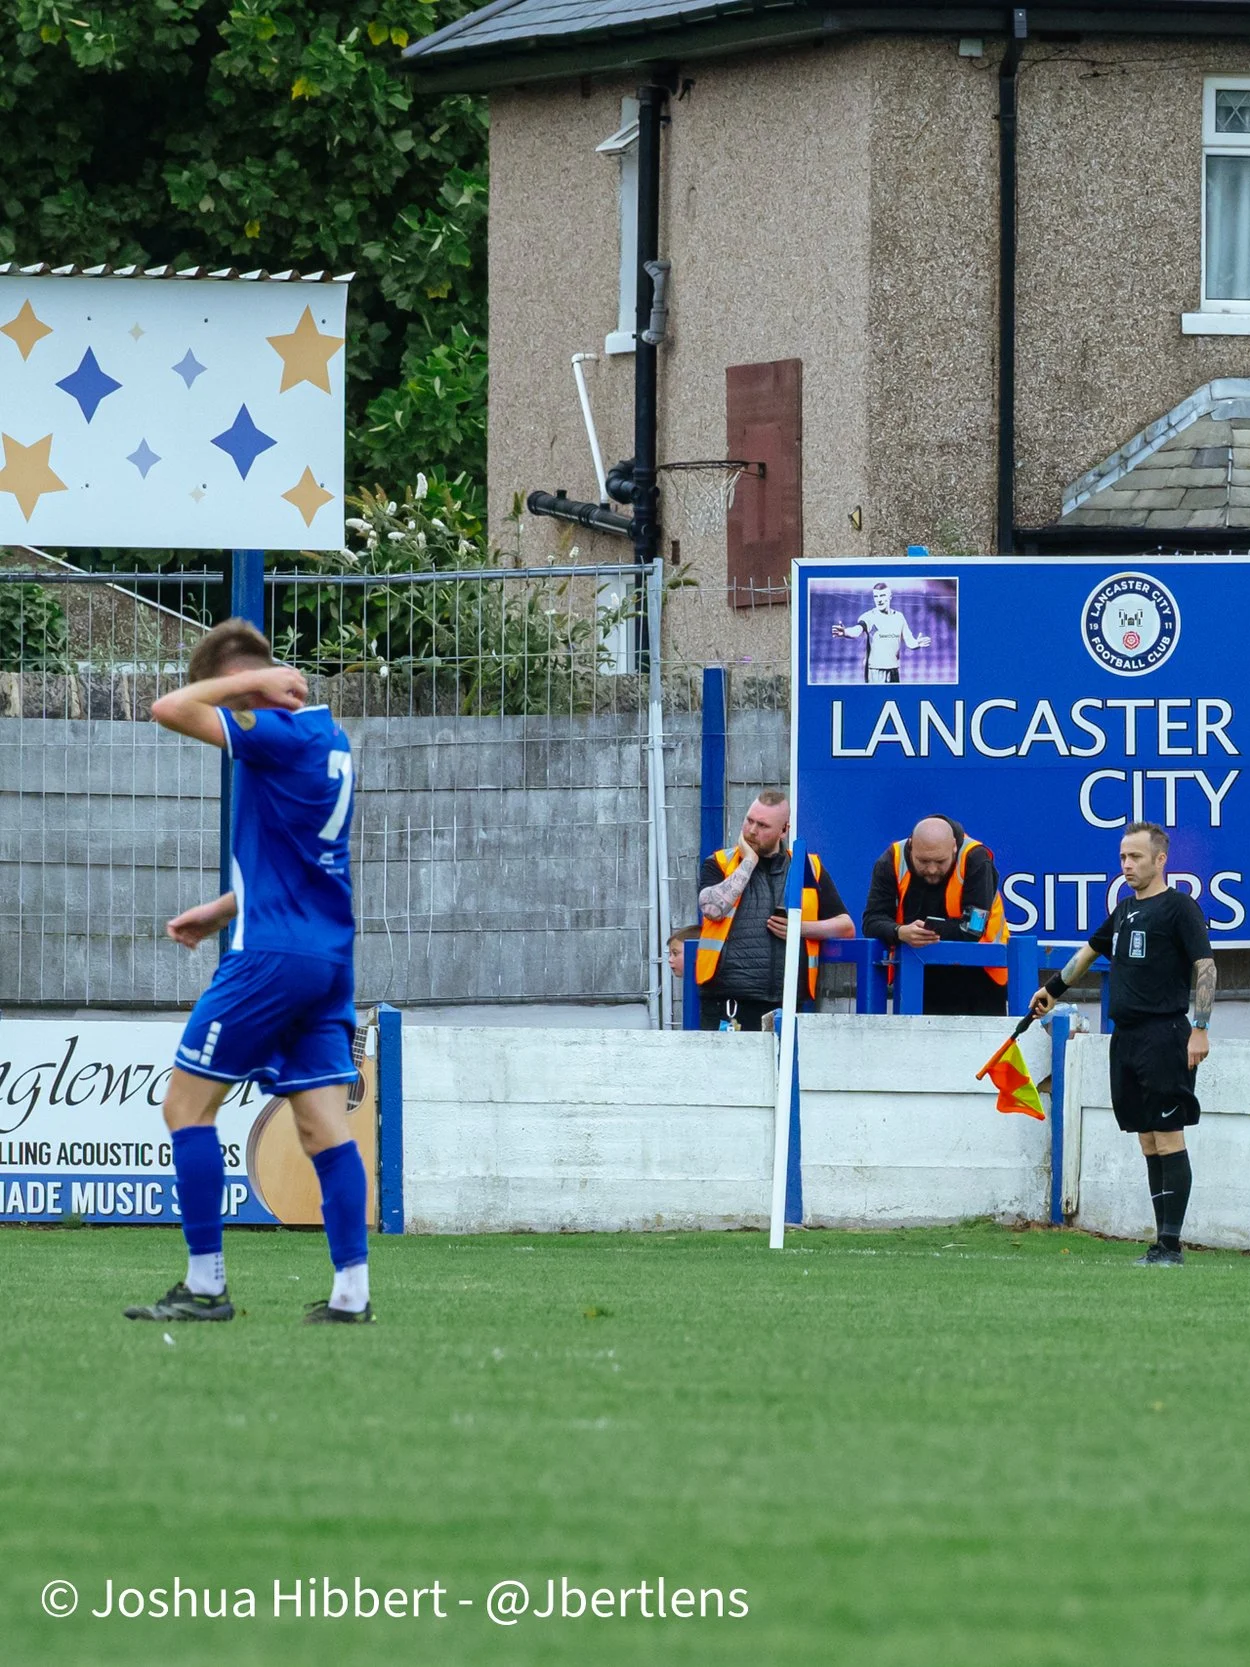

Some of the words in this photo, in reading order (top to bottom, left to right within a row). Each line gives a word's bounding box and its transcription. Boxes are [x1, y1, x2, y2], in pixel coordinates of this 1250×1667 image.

[1090, 580, 1151, 617] LANCASTER
[1151, 590, 1172, 615] CITY
[1089, 623, 1099, 631] 19
[1164, 622, 1172, 630] 11
[1091, 636, 1146, 669] FOOTBALL
[1147, 636, 1171, 663] CLUB
[832, 698, 1239, 757] LANCASTER
[317, 750, 351, 841] 7
[1079, 769, 1239, 828] CITY
[1002, 871, 1246, 933] SITRS
[56, 1143, 153, 1167] ACOUSTIC
[0, 1181, 63, 1214] ADE
[71, 1182, 163, 1216] MUSIC
